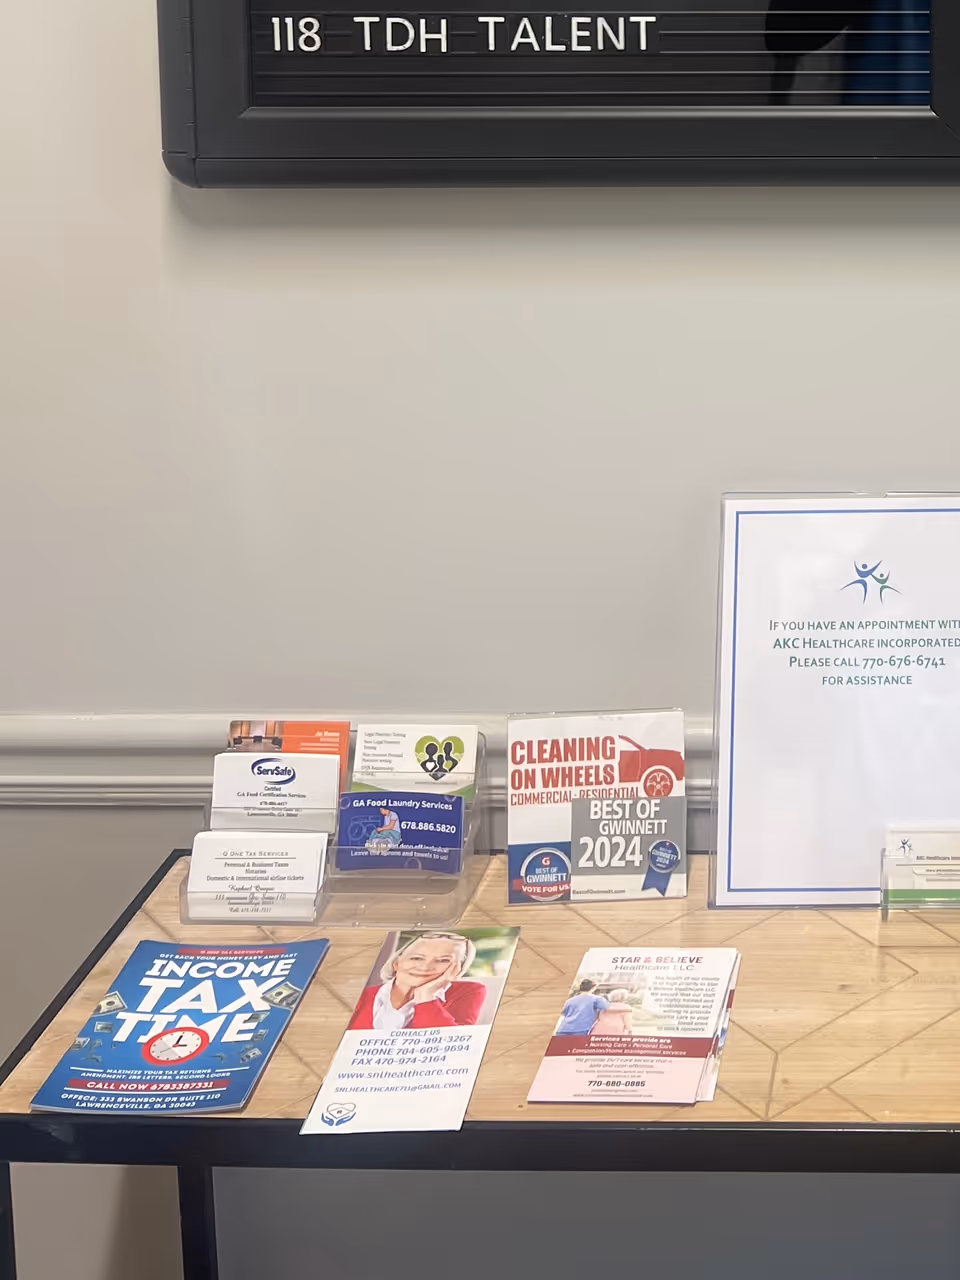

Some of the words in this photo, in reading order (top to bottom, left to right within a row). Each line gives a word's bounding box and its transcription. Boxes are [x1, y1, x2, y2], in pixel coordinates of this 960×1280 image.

[272, 18, 321, 51] 118
[354, 17, 446, 52] TDH
[478, 17, 656, 51] TALENT
[781, 621, 805, 631] YOU
[807, 621, 836, 630] HAVE
[839, 620, 855, 630] AN
[857, 620, 936, 630] APPOINTMENT
[773, 638, 800, 649] AKC
[833, 657, 860, 667] CALL
[862, 655, 946, 670] 770-676-6741
[822, 676, 844, 686] FOR
[846, 675, 913, 685] ASSISTANCE
[510, 735, 616, 765] CLEANING
[256, 766, 292, 776] ServSafe
[510, 768, 536, 790] ON
[541, 763, 615, 789] WHEELS
[510, 790, 572, 806] COMMERCIAL
[580, 787, 640, 799] RESIDENTIAL
[352, 800, 365, 808] GA
[366, 799, 387, 807] Food
[388, 799, 420, 809] Laundry
[421, 800, 453, 810] Services
[590, 800, 634, 820] BEST
[636, 799, 661, 819] OF
[400, 821, 456, 834] 678.886.5820
[599, 819, 667, 835] GWINNETT
[578, 836, 643, 868] 2024
[526, 873, 567, 883] GWINNETT
[521, 885, 541, 893] VOTE
[542, 885, 558, 893] FOR
[612, 956, 642, 964] STAR
[655, 956, 704, 964] BELIEVE
[145, 958, 296, 979] INCOME
[136, 977, 286, 1013] TAX
[390, 1029, 427, 1037] CONTACT
[359, 1038, 397, 1047] OFFICE
[401, 1035, 472, 1046] 770-891-3267
[355, 1048, 394, 1057] PHONE
[395, 1045, 470, 1056] 704-605-9694
[350, 1057, 373, 1066] FAX
[374, 1055, 447, 1066] 470-974-2164
[337, 1067, 469, 1080] www.snlhealthcare.com
[86, 1081, 115, 1090] CALL
